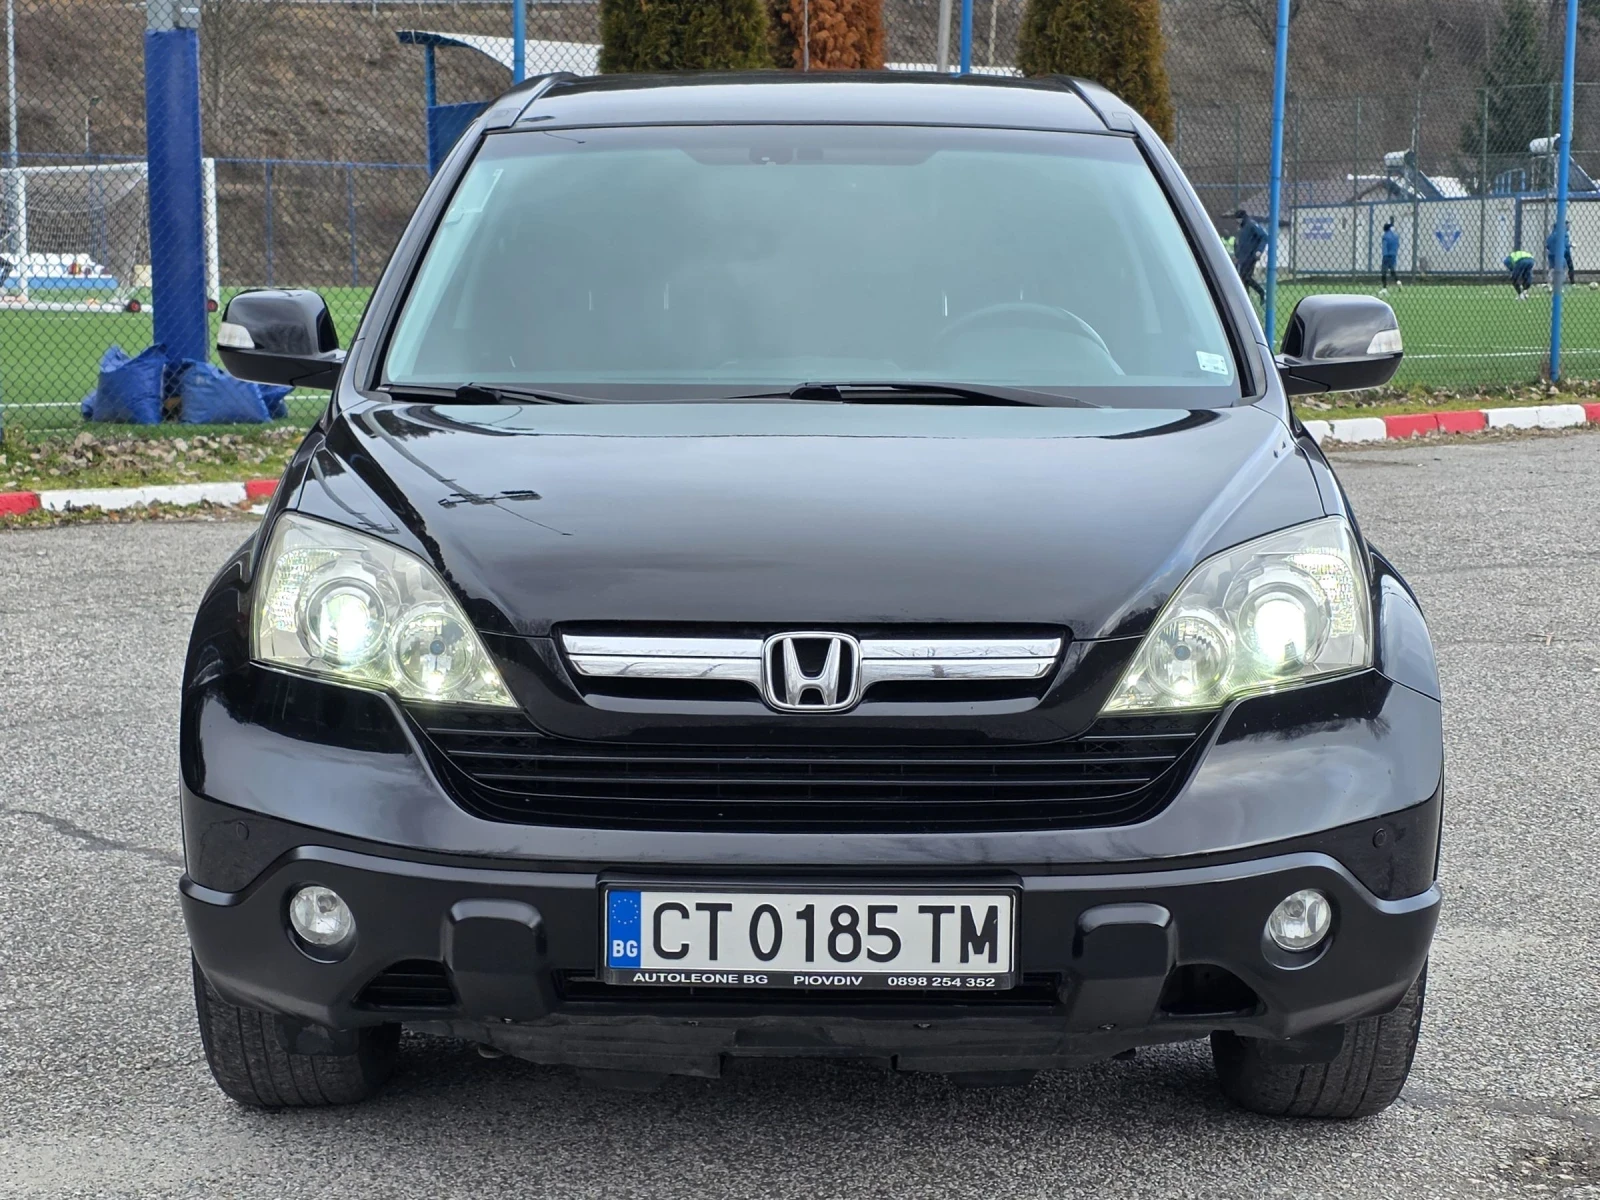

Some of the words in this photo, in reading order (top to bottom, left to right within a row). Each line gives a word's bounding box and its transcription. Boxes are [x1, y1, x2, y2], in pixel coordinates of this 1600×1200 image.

[652, 902, 733, 961] CT
[748, 903, 902, 963] 0185
[917, 904, 999, 964] TM
[612, 939, 638, 958] BG
[632, 972, 739, 984] AUTOLEONE
[743, 974, 768, 985] BG
[793, 975, 863, 986] PIOVDIV
[887, 976, 928, 987] 0898
[931, 977, 962, 987] 254
[965, 977, 996, 987] 352
